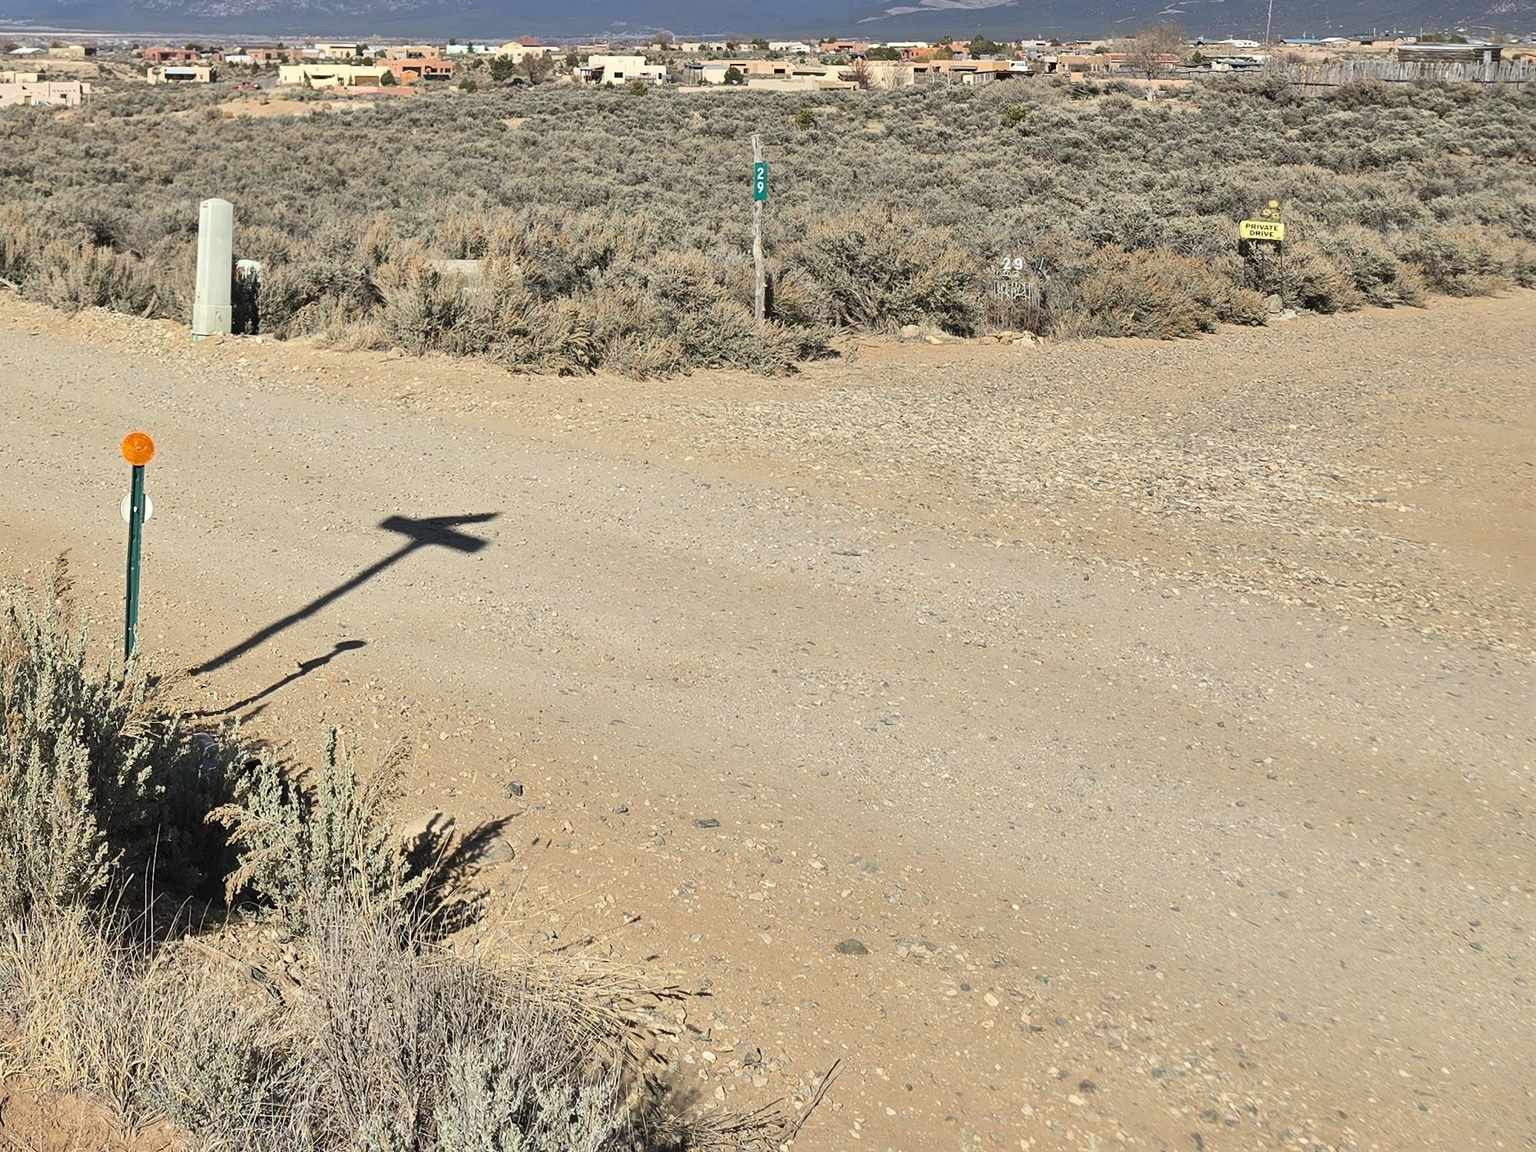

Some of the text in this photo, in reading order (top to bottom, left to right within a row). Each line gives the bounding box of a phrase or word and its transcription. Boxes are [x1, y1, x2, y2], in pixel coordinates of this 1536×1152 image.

[757, 167, 764, 193] 29
[1245, 223, 1278, 231] PRIVATE
[1002, 257, 1024, 270] 29
